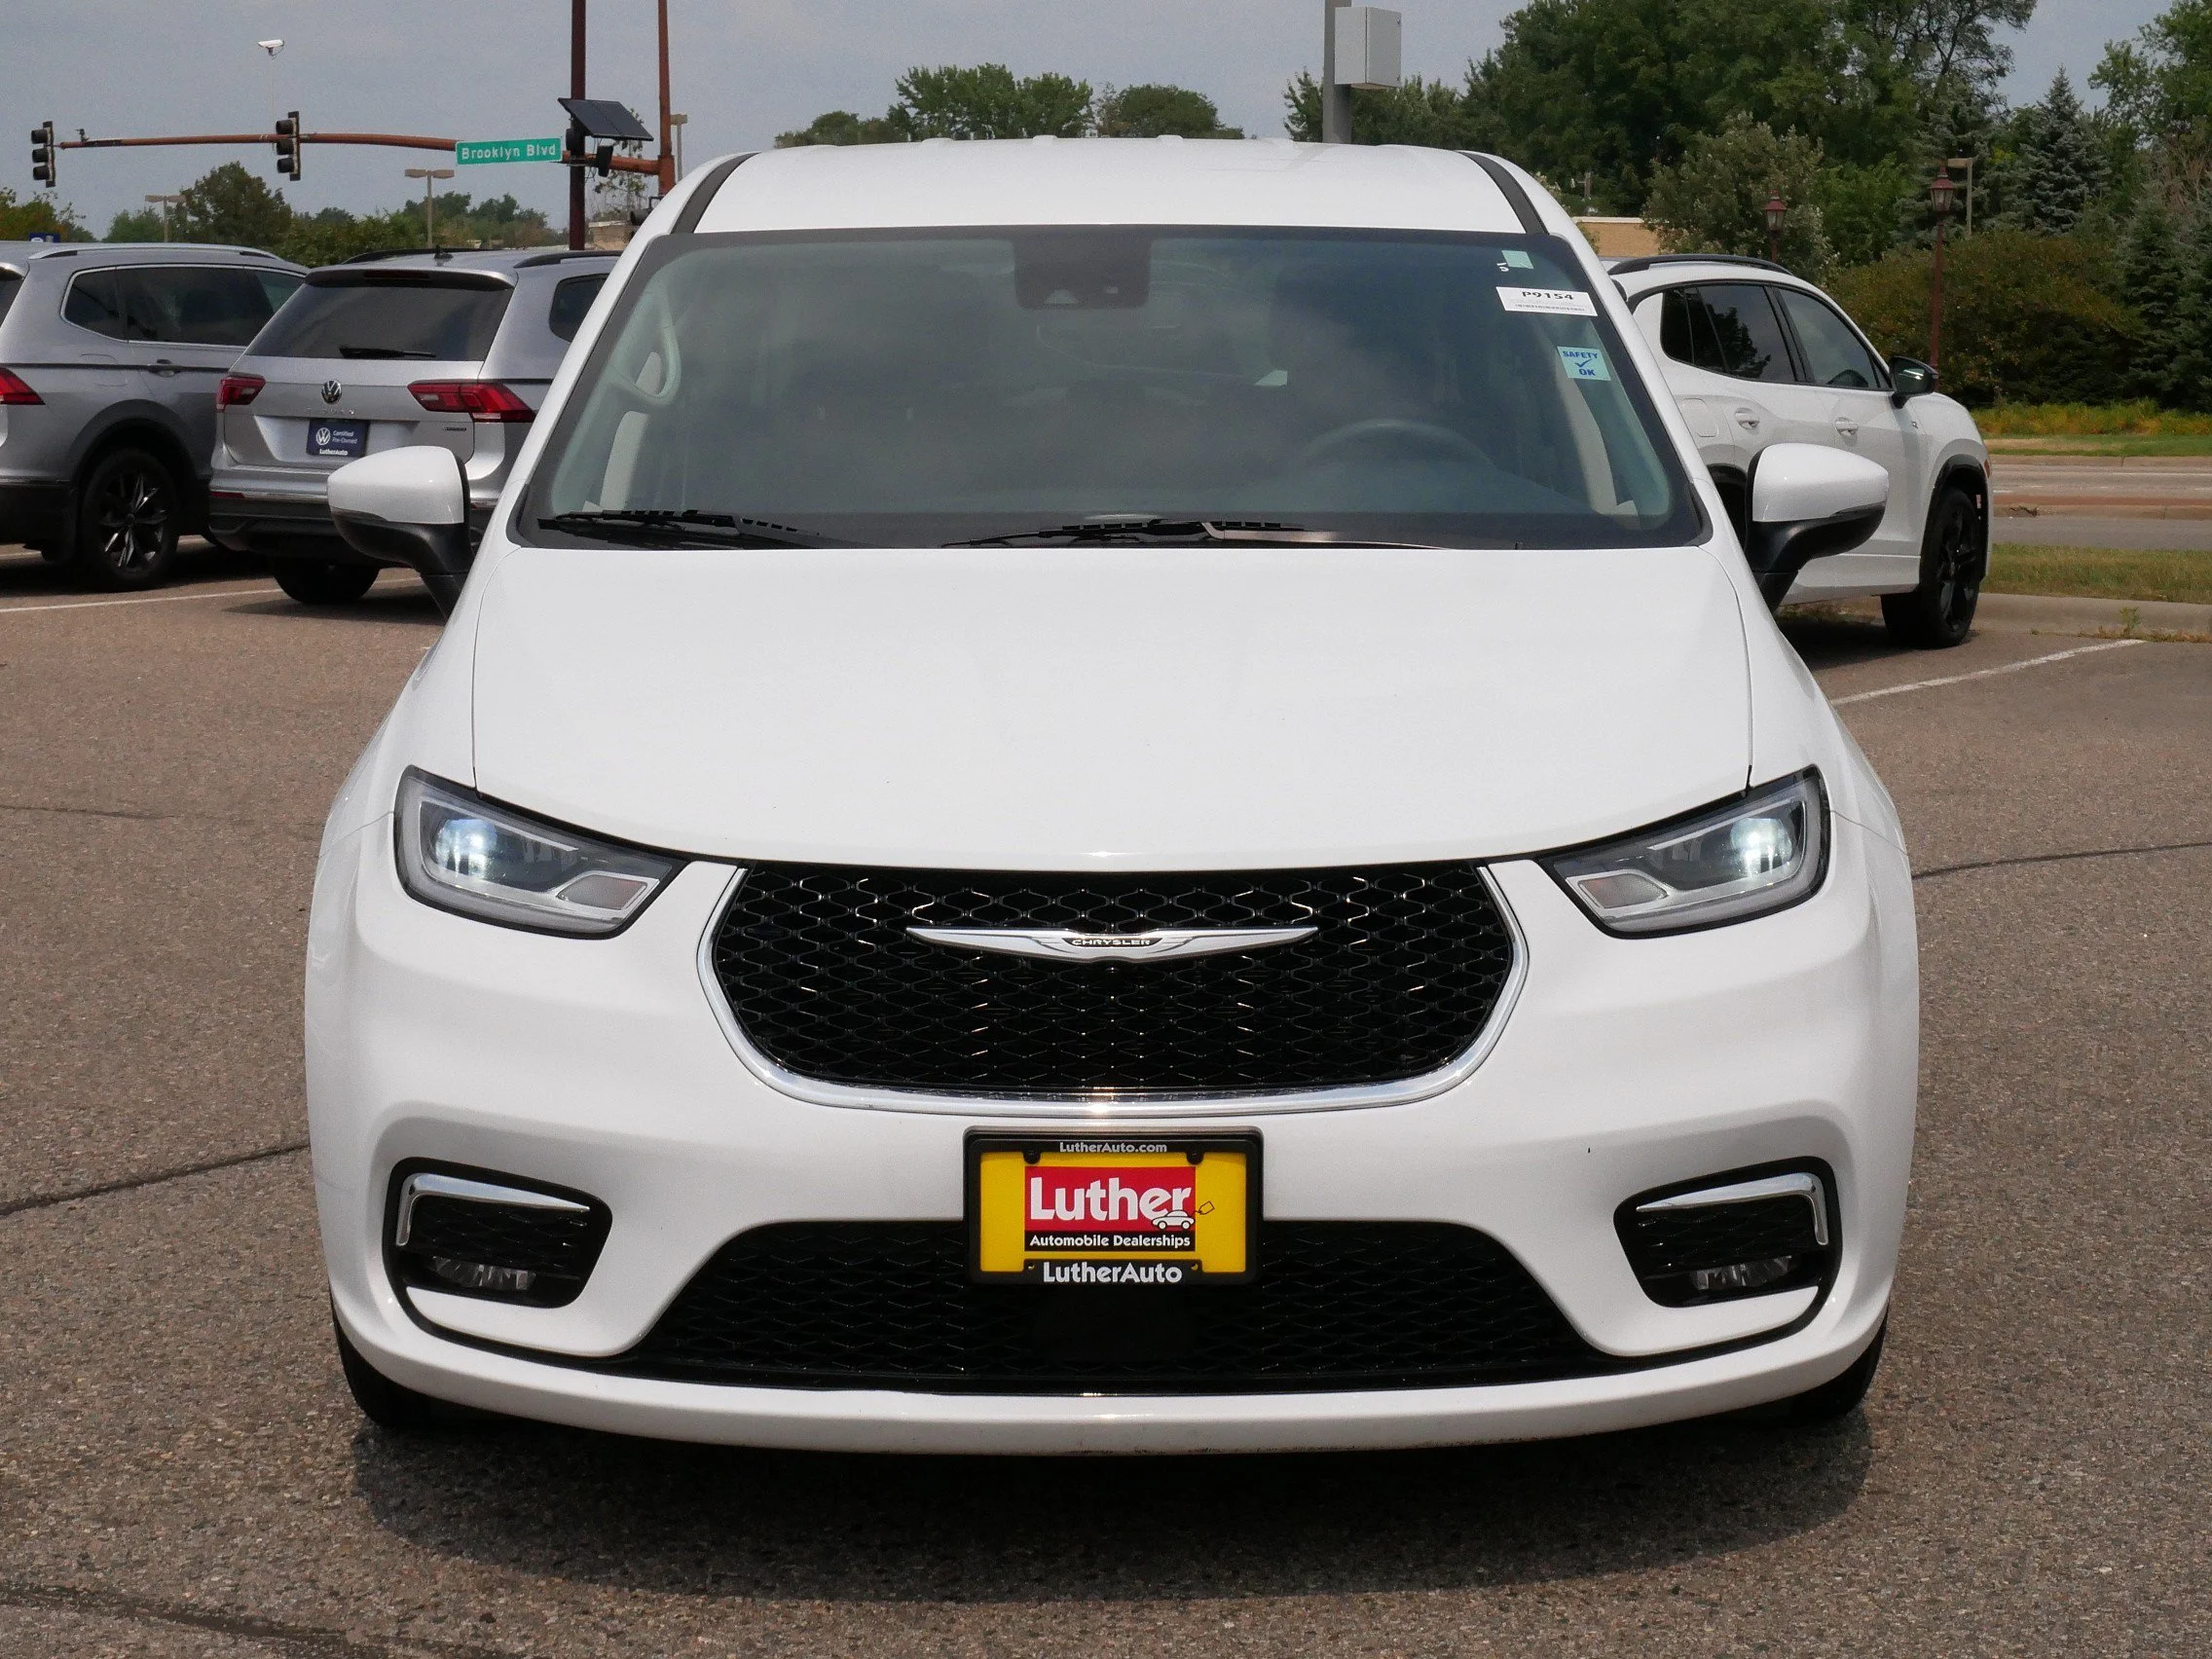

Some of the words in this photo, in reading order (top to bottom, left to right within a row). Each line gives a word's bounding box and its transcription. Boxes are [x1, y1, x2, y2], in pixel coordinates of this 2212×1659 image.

[461, 146, 520, 160] Brooklyn
[527, 143, 556, 156] Blvd
[1522, 291, 1573, 300] P9154
[1562, 350, 1598, 359] SAFETY
[1059, 1141, 1167, 1153] LutherAuto.com
[1030, 1176, 1193, 1221] Luther
[1029, 1235, 1109, 1247] Automobile
[1113, 1235, 1191, 1248] Dealerships
[1043, 1261, 1183, 1283] LutherAuto
